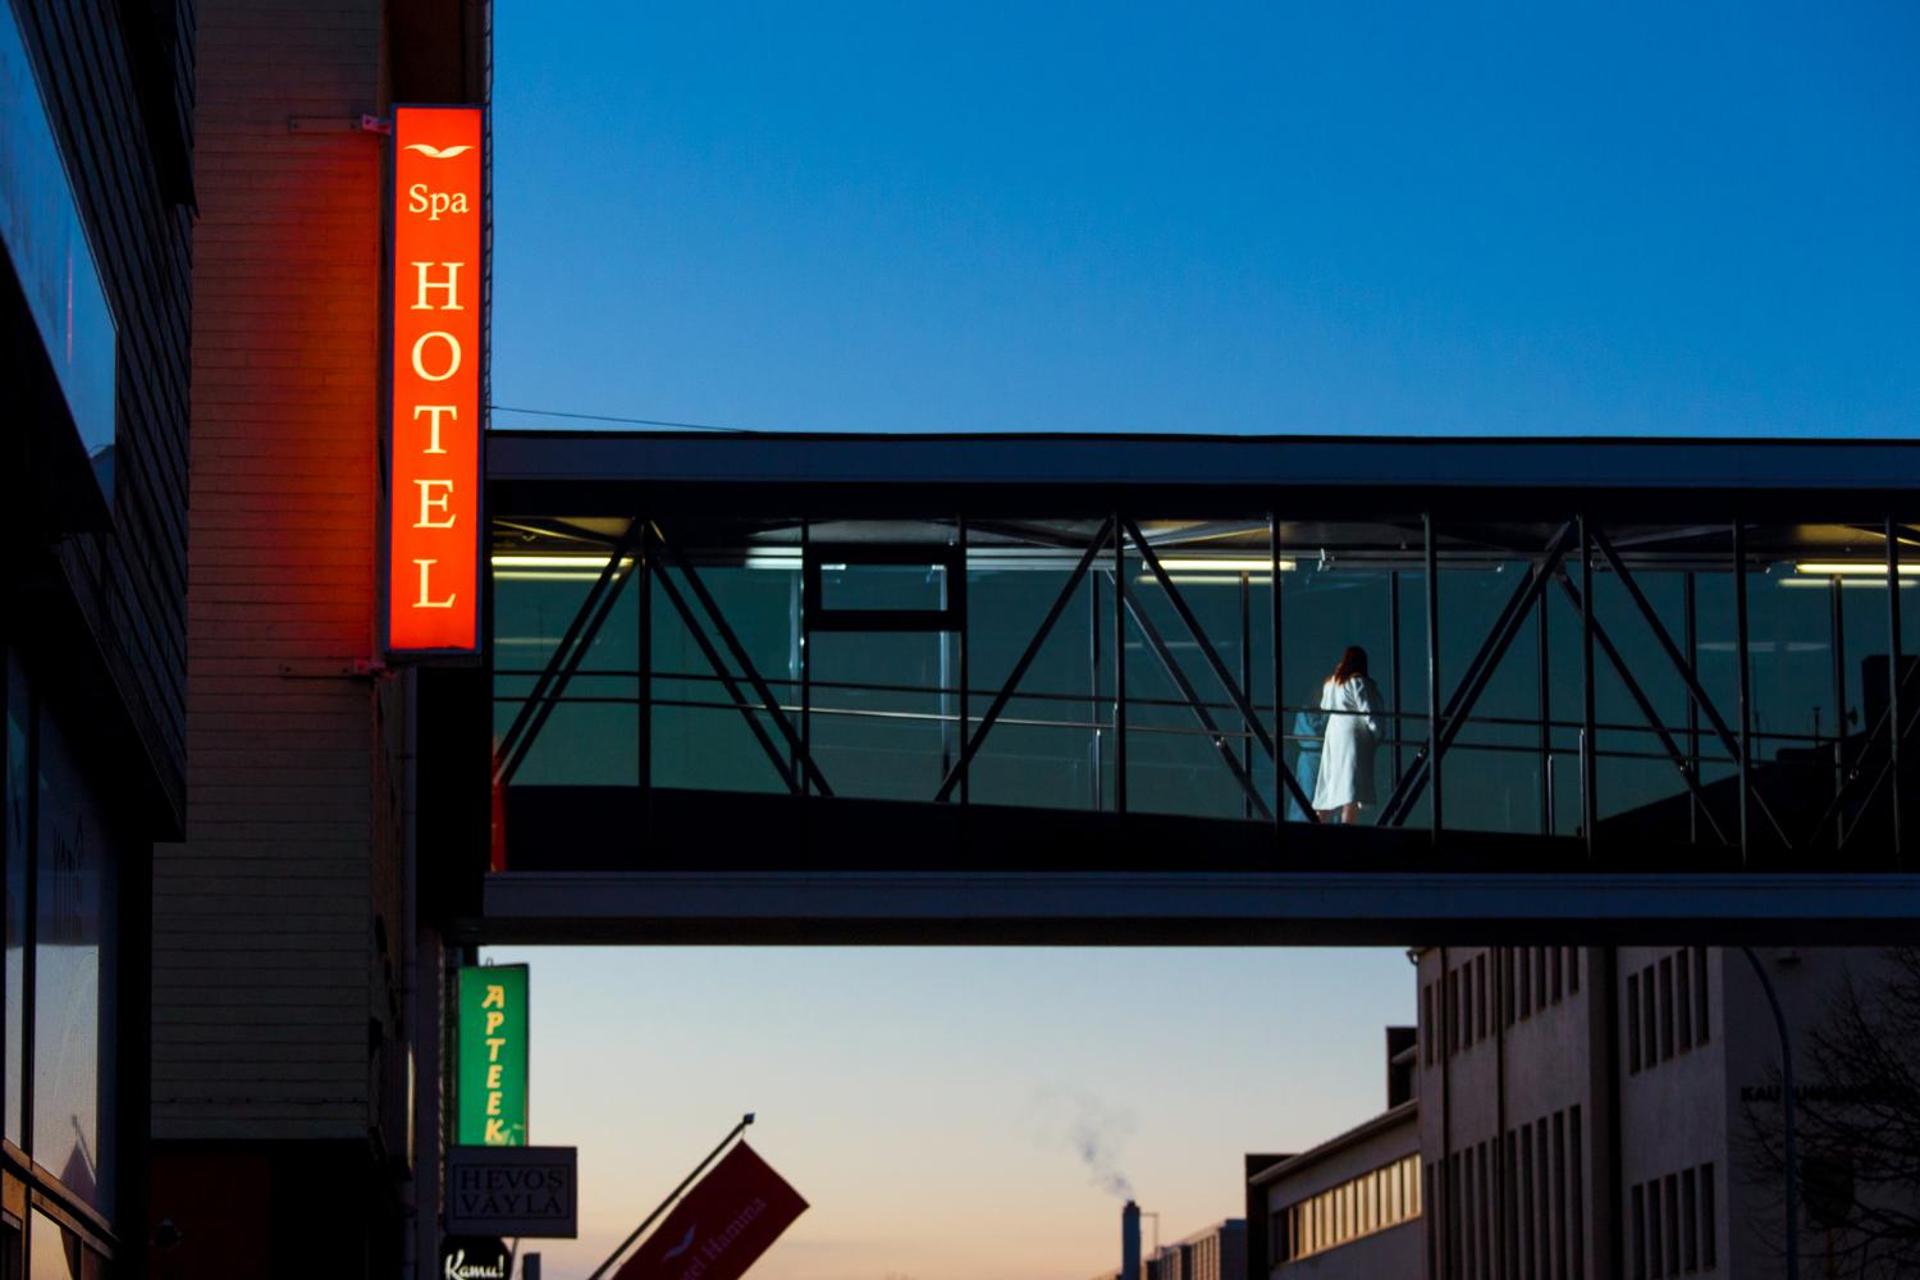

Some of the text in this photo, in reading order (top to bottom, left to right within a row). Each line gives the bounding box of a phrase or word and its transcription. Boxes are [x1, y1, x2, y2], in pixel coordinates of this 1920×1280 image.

[409, 183, 469, 221] Spa
[411, 260, 464, 608] HOTEL
[481, 984, 508, 1146] APTEEK
[461, 1168, 563, 1191] HEVOS
[444, 1248, 505, 1280] Kamu!
